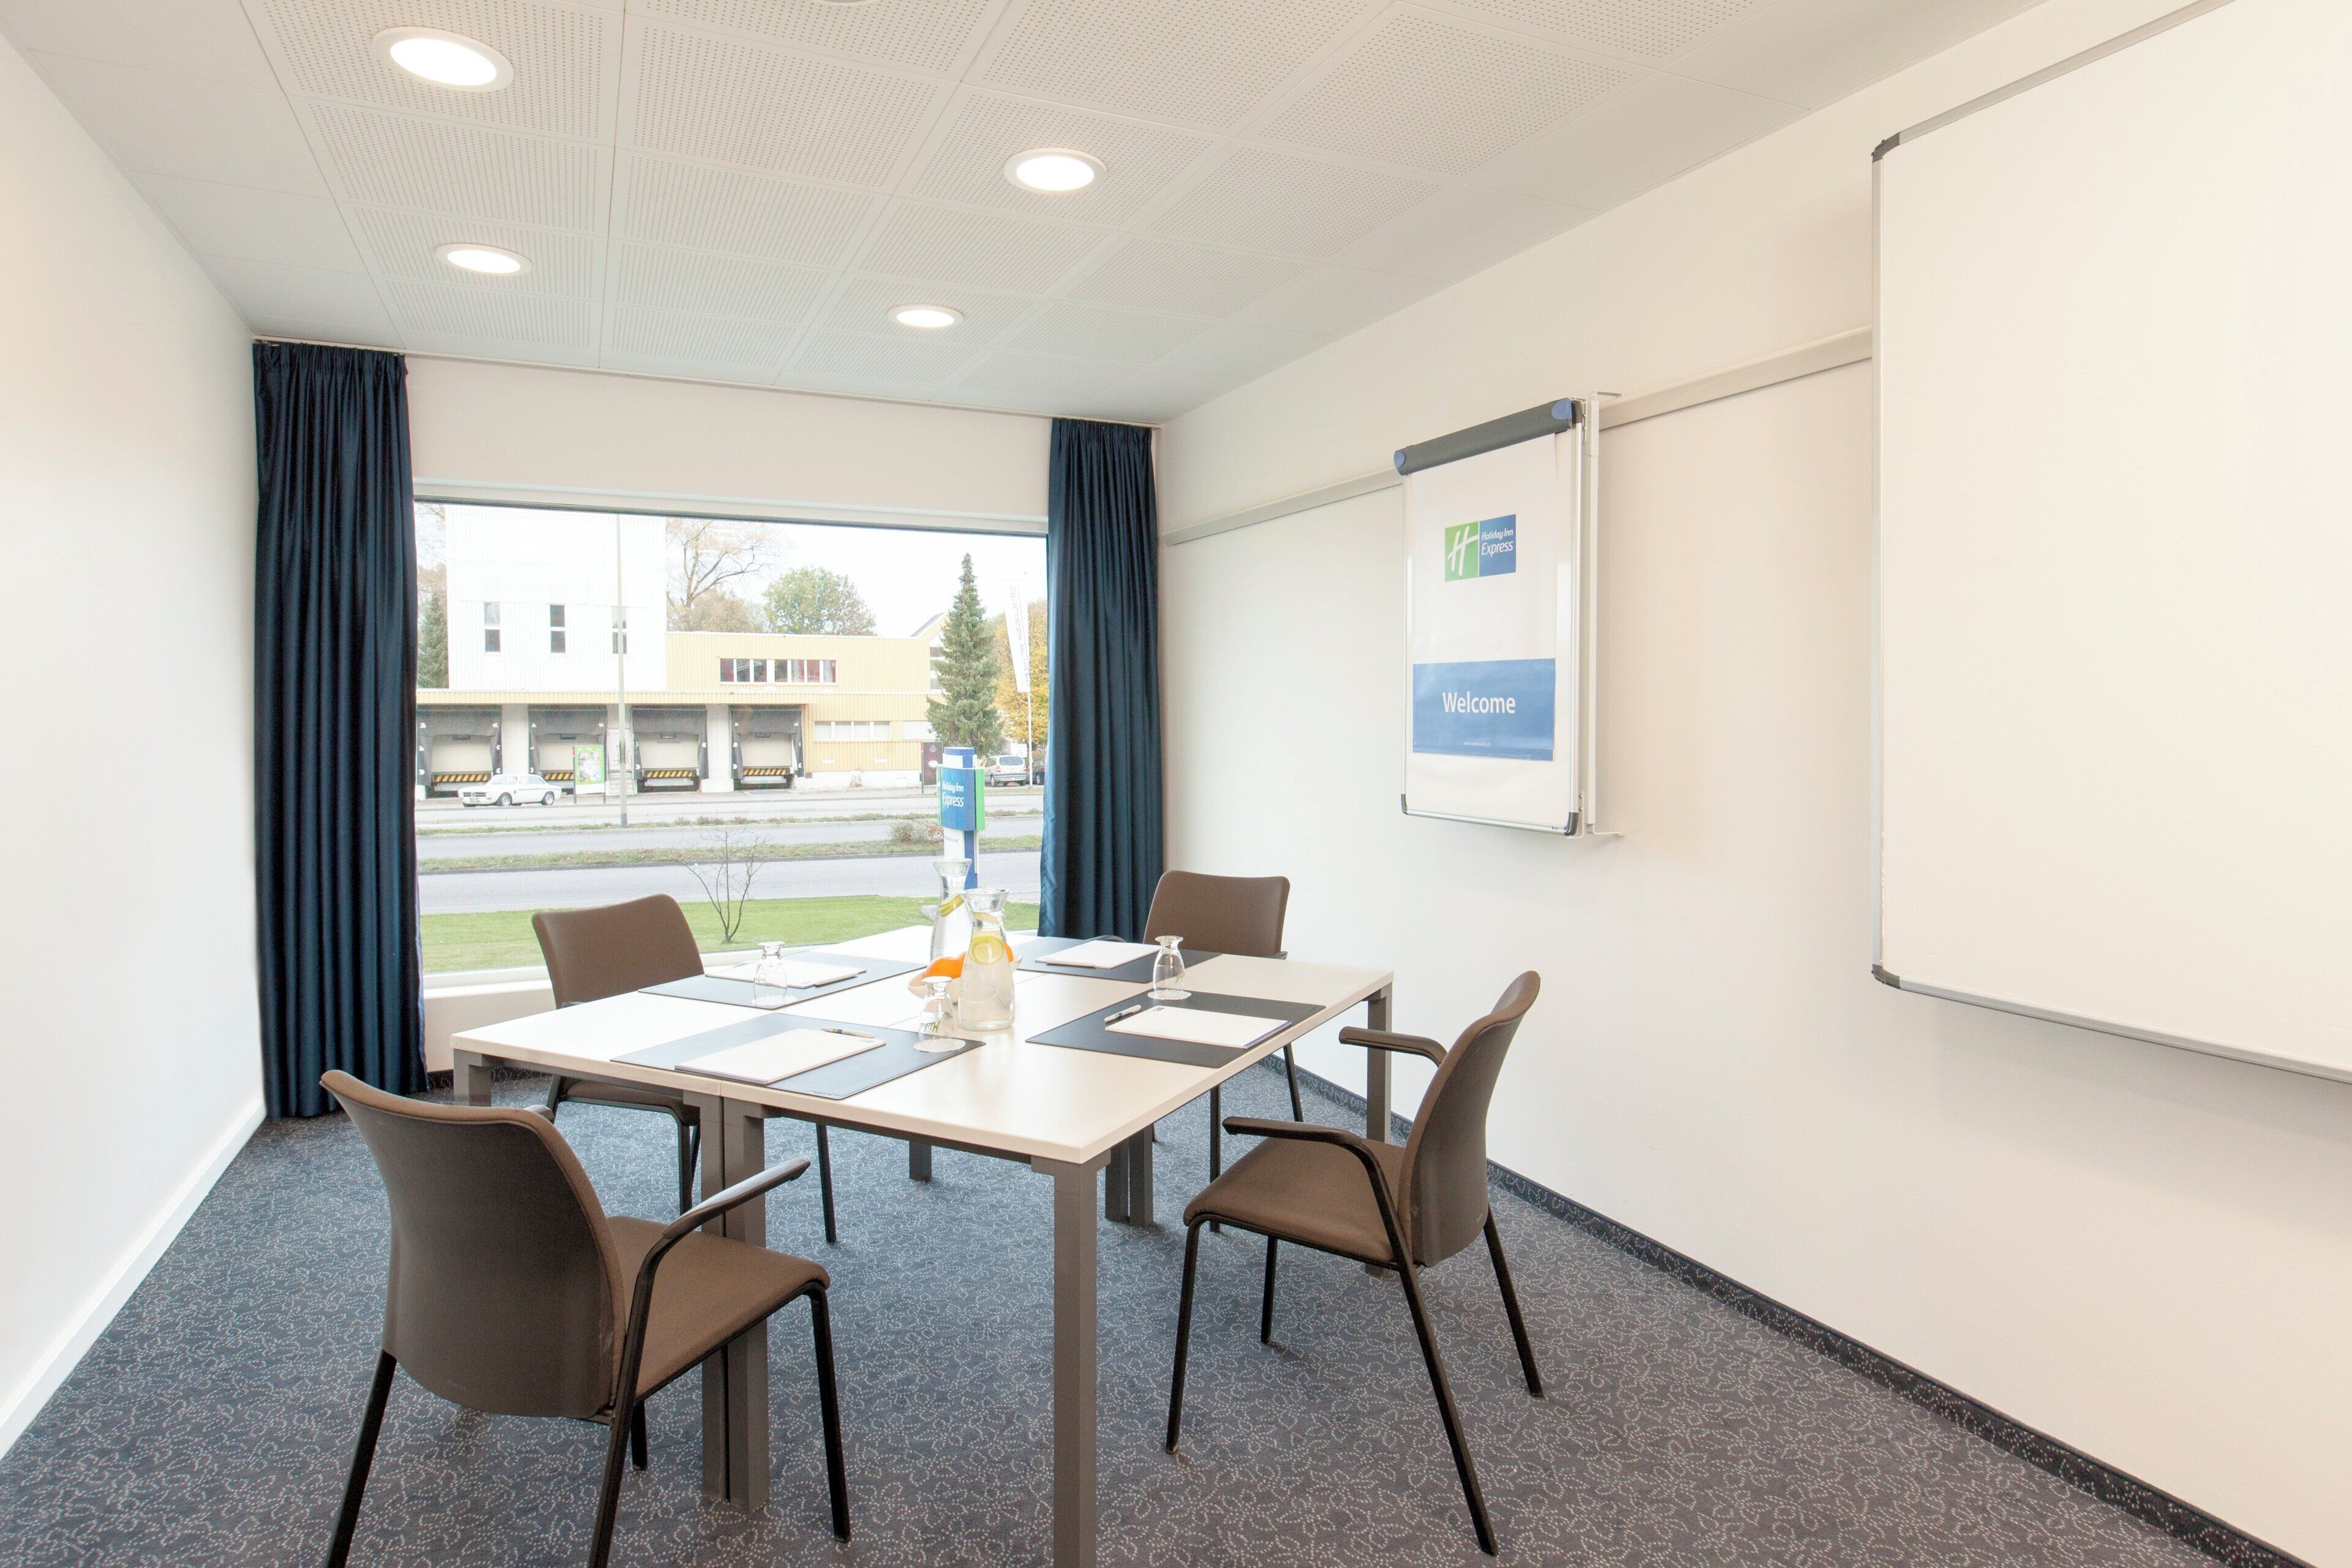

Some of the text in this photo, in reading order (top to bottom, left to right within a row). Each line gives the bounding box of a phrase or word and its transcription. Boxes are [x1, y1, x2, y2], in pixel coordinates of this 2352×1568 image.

[1481, 528, 1513, 540] Holiday Inn
[1481, 541, 1513, 557] Express
[1442, 691, 1516, 714] Welcome
[942, 781, 964, 793] Holiday Inn
[942, 791, 964, 808] Express
